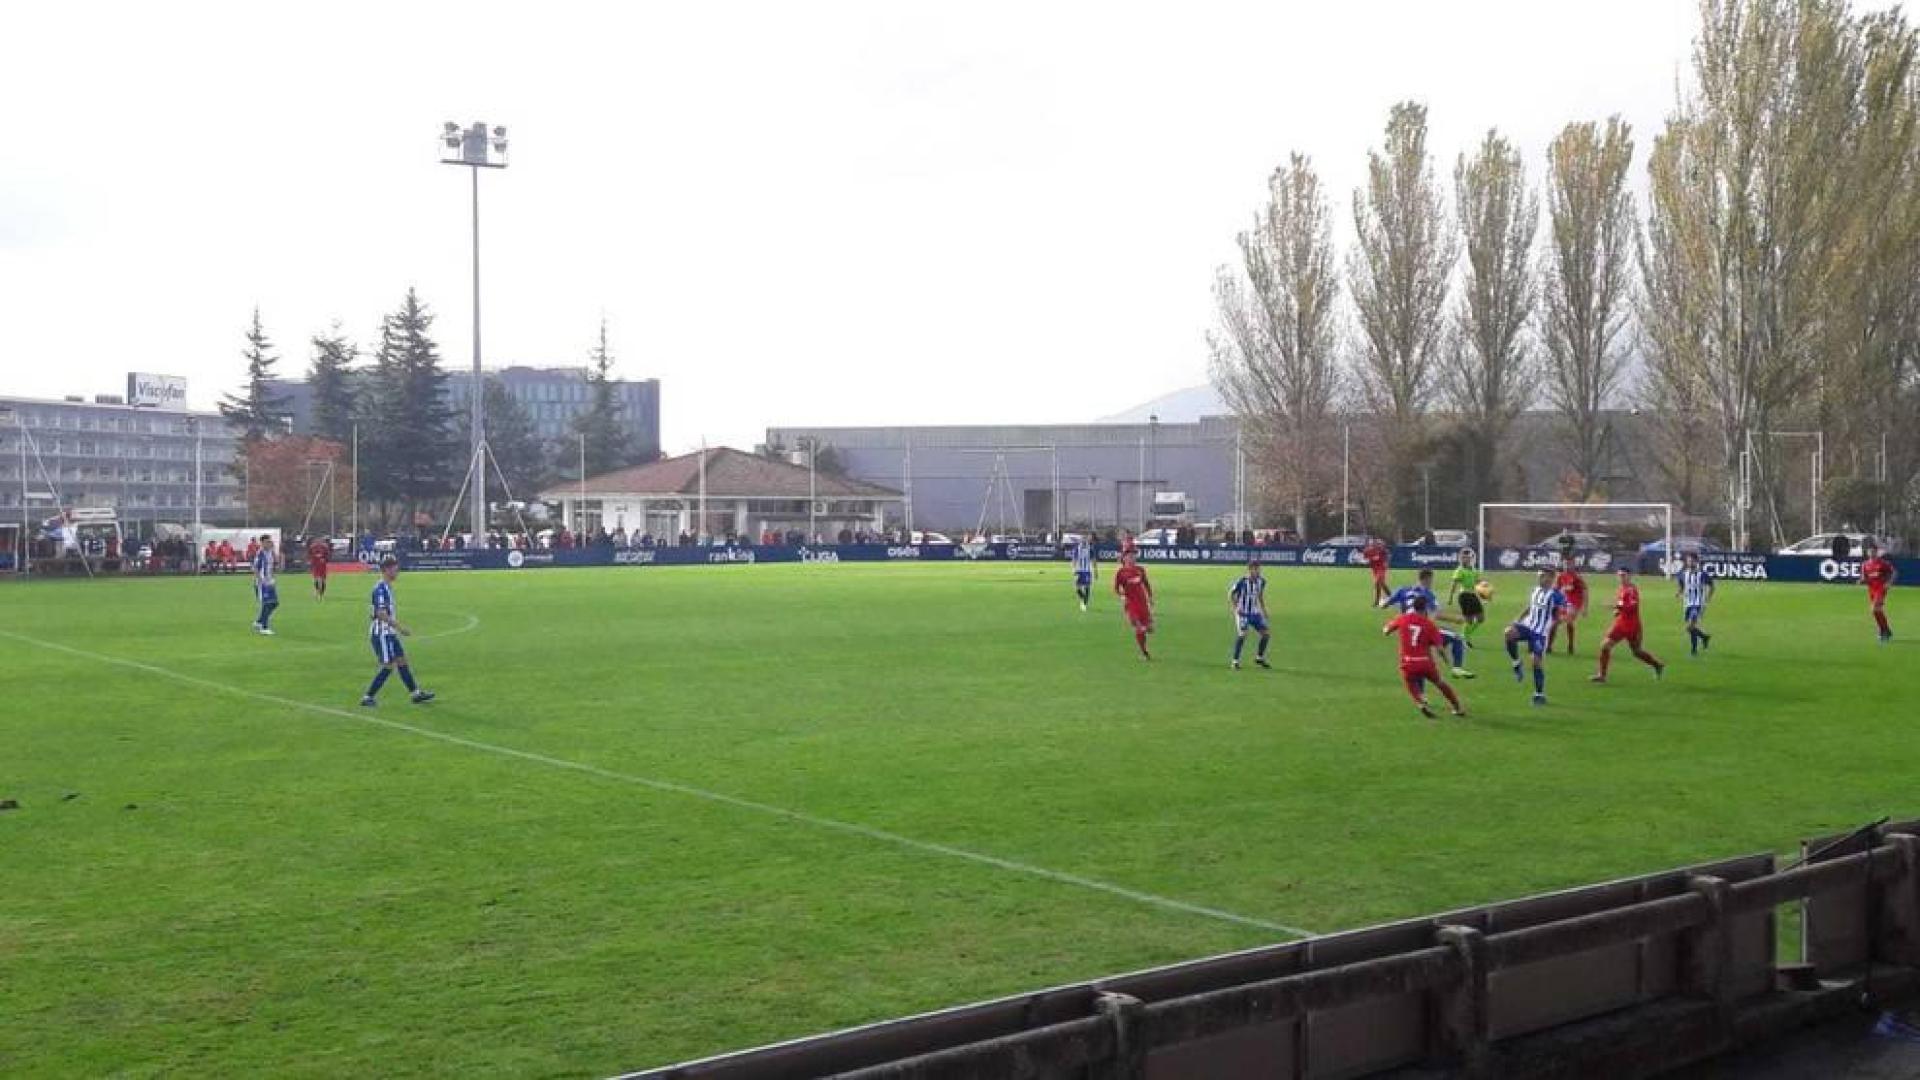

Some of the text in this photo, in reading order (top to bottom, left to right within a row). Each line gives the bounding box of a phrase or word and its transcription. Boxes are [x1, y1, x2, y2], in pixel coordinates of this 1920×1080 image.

[138, 382, 185, 401] Viscofan
[709, 547, 755, 564] ranking
[1702, 561, 1768, 579] CUNSA
[1820, 559, 1861, 580] OSE
[1408, 624, 1422, 647] 7
